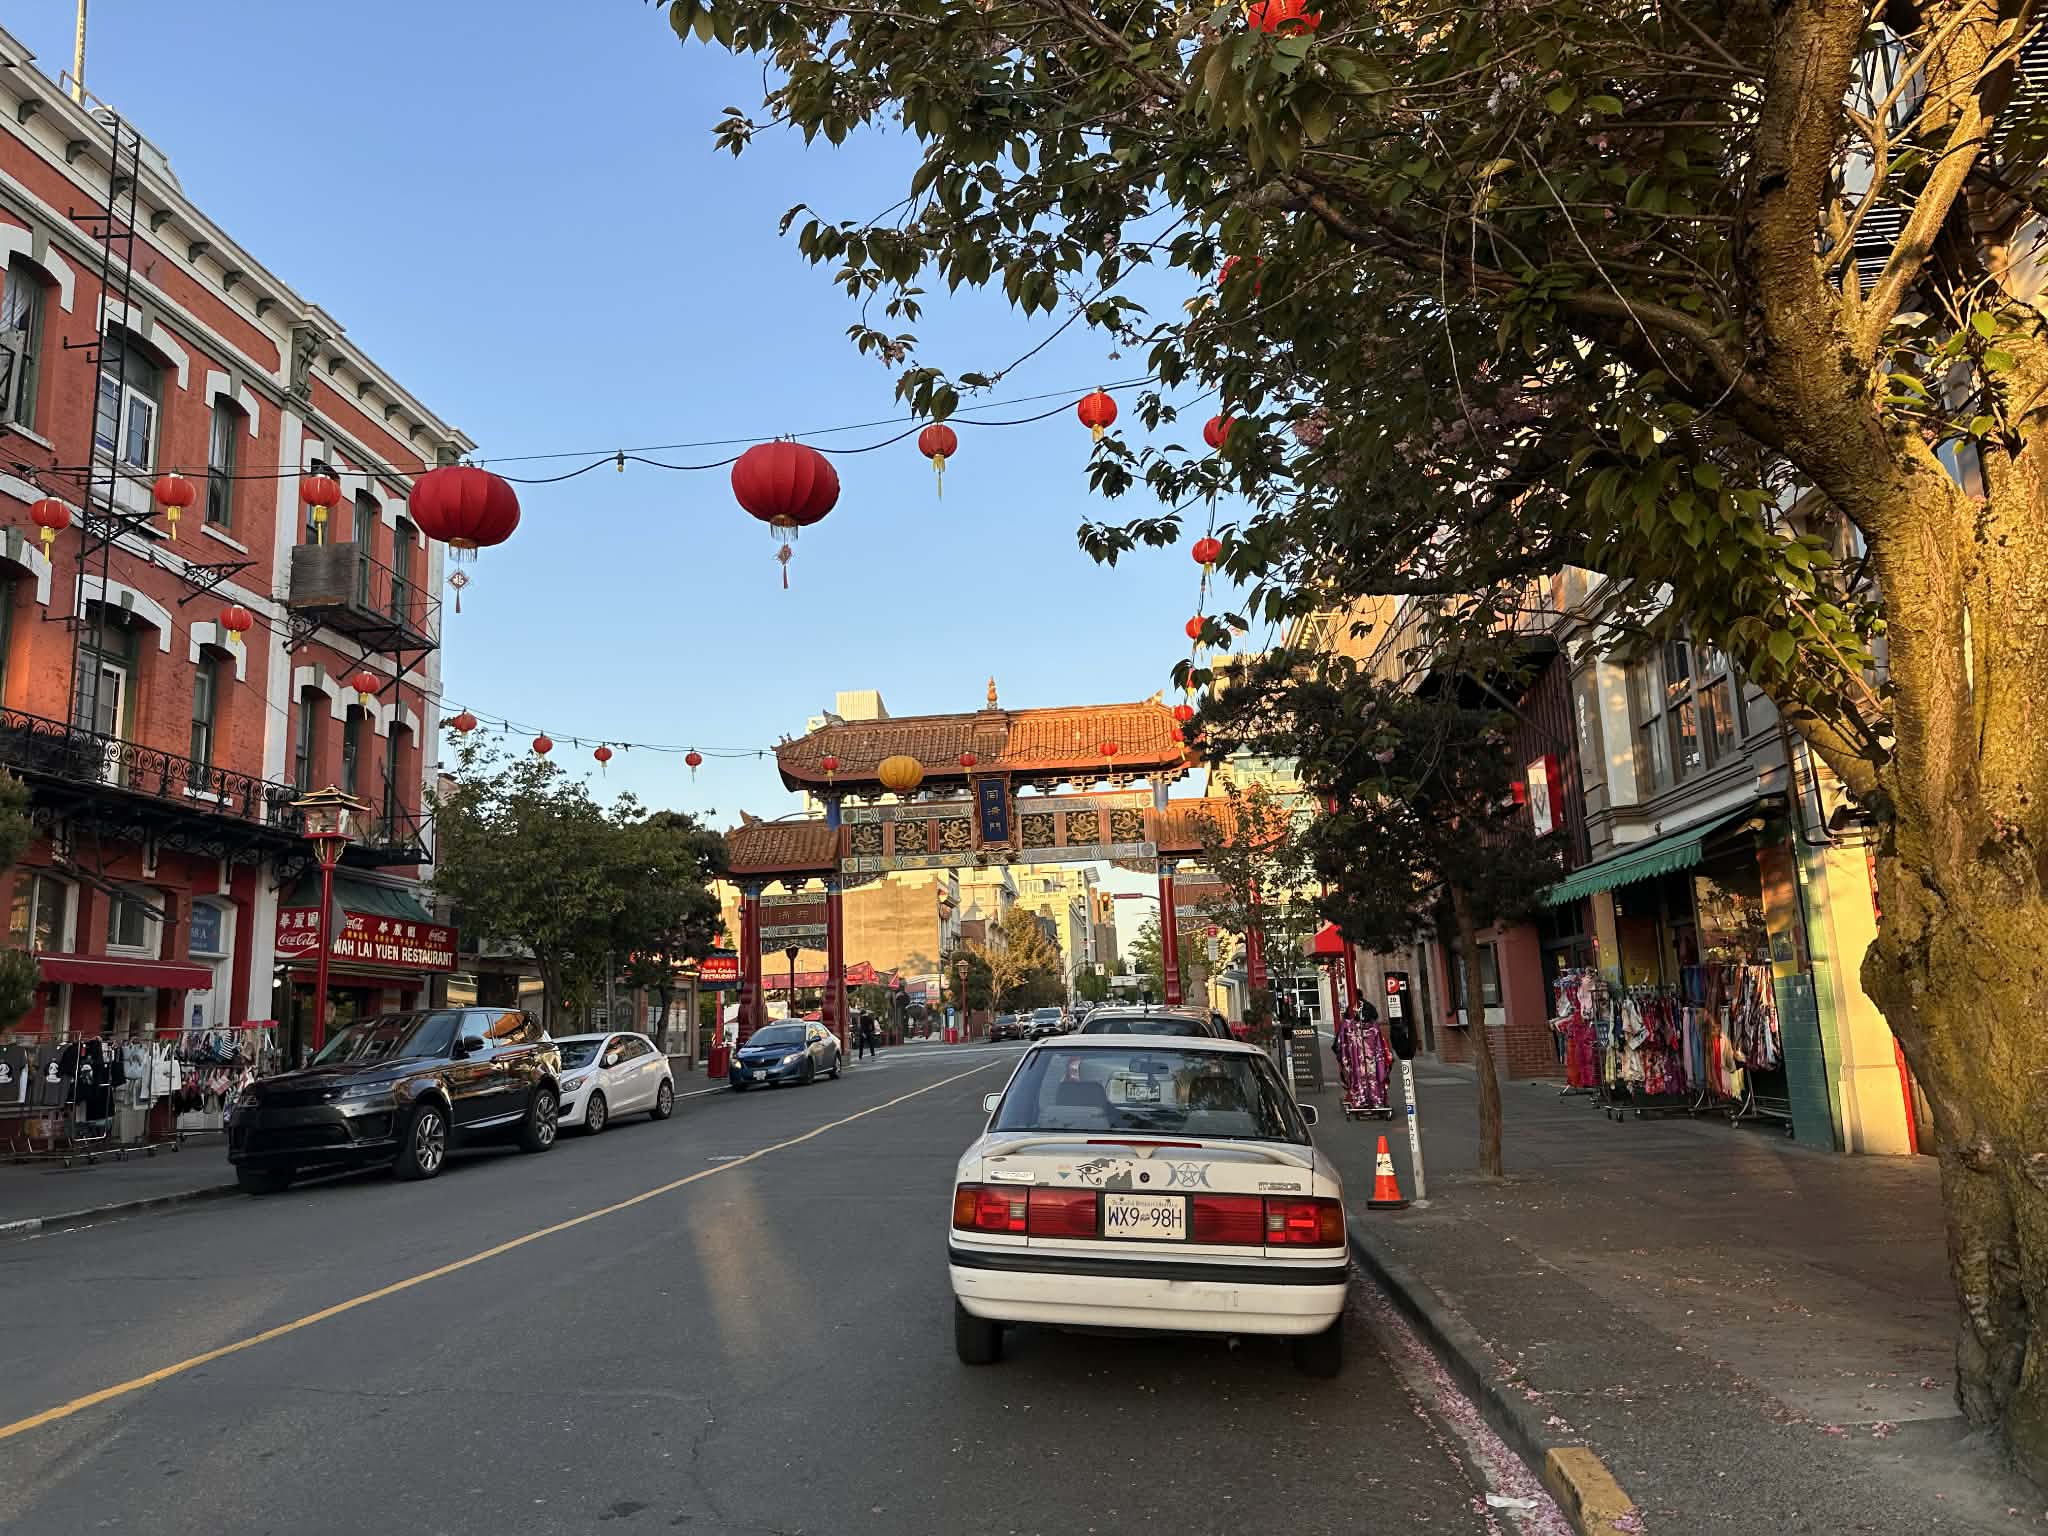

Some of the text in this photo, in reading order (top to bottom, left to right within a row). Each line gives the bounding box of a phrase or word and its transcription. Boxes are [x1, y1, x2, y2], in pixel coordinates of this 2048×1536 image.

[333, 938, 355, 956] WAH
[358, 941, 373, 958] LAI
[375, 943, 399, 960] YUEN
[401, 946, 454, 967] RESTAURANT
[1387, 979, 1396, 991] P
[1108, 1206, 1182, 1229] WX9 98H
